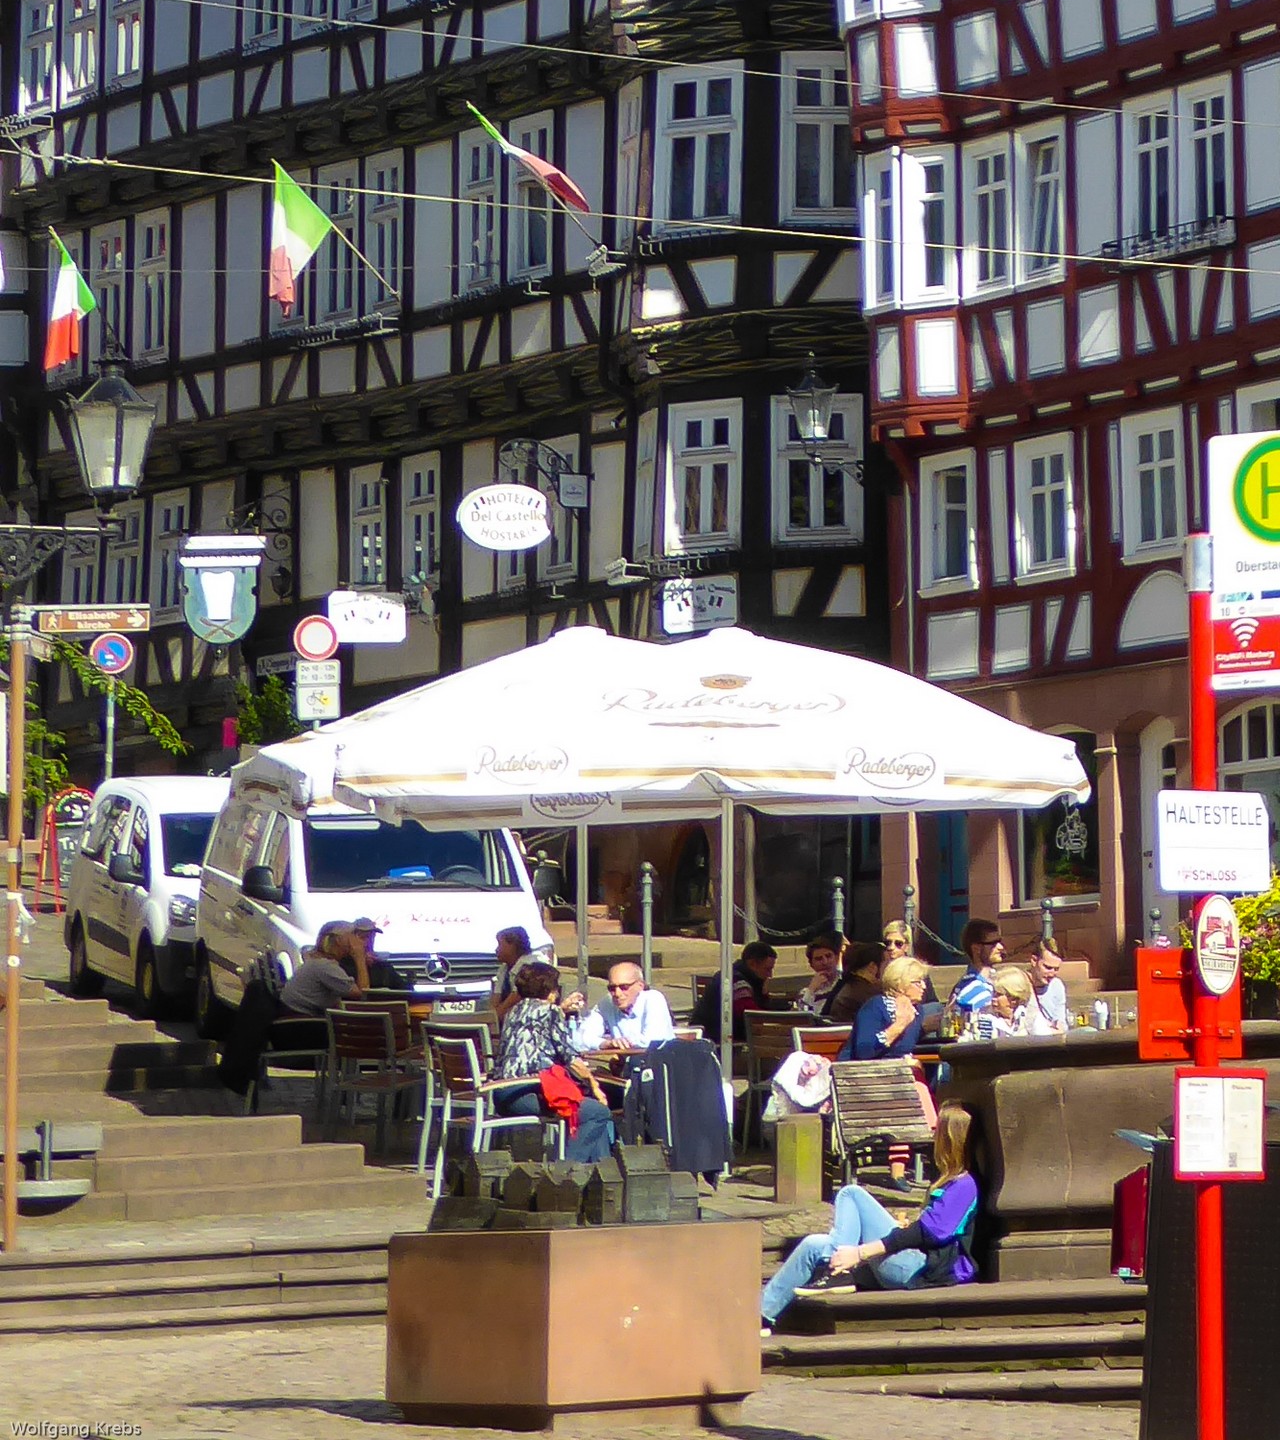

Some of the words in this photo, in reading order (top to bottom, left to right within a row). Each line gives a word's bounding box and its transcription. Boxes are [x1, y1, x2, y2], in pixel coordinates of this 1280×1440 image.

[487, 492, 526, 506] HOTEL
[471, 510, 492, 522] Del
[496, 509, 546, 522] Castello
[68, 611, 121, 621] Elisabeth-
[77, 621, 112, 629] kirche
[474, 745, 567, 782] Radeberger
[843, 747, 935, 785] Radeberger
[1166, 803, 1262, 826] HALTESTELLE
[1192, 869, 1237, 881] SCHLOSS
